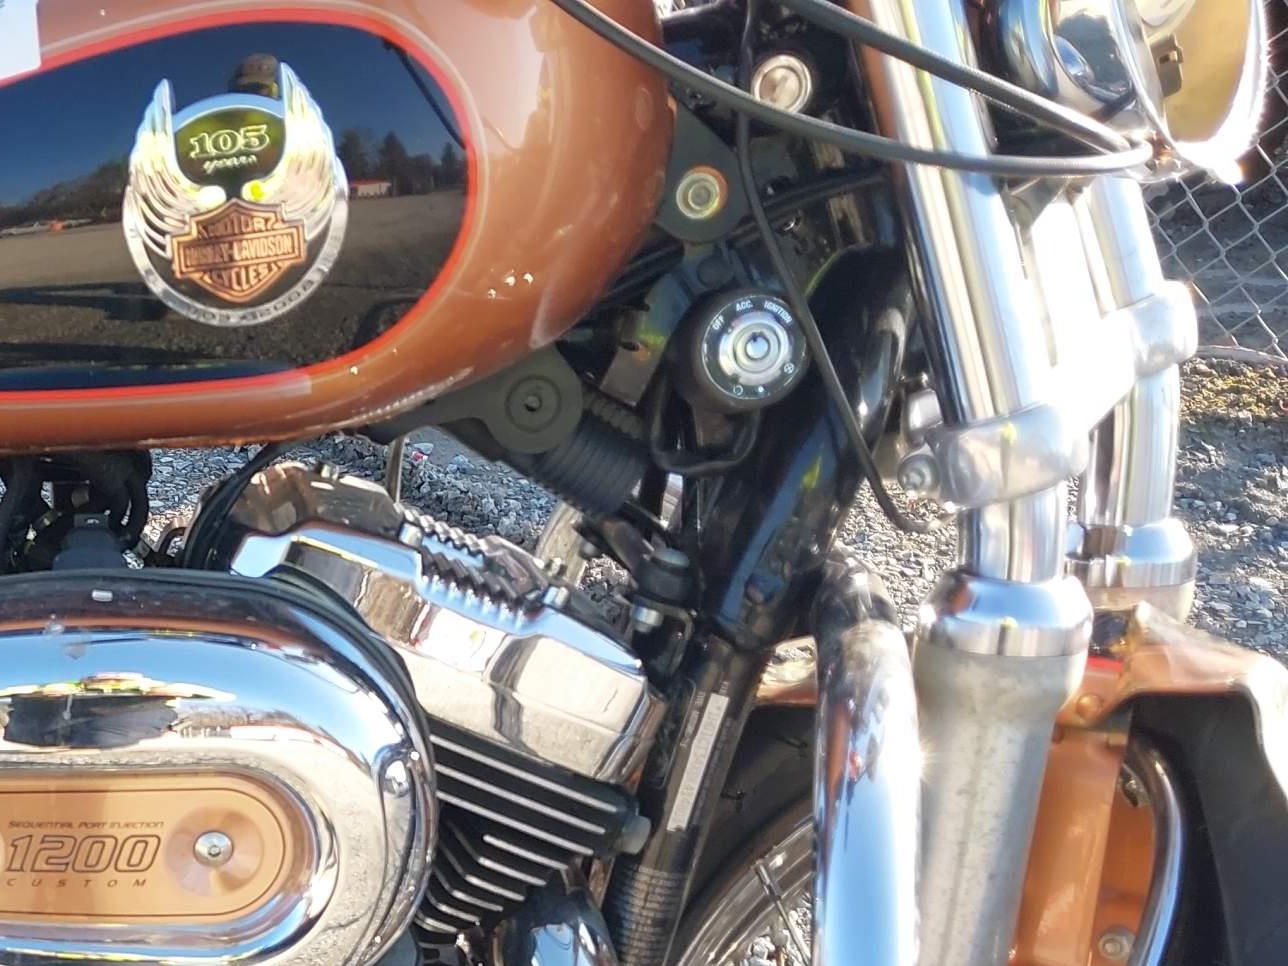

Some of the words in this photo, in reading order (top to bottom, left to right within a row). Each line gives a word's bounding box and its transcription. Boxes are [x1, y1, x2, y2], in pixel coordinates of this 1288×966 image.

[190, 124, 269, 159] 105
[763, 300, 793, 324] IGNITION
[711, 315, 725, 331] OFF
[78, 820, 107, 830] PORT
[5, 833, 161, 873] 1200
[6, 878, 147, 888] CUSTOM
